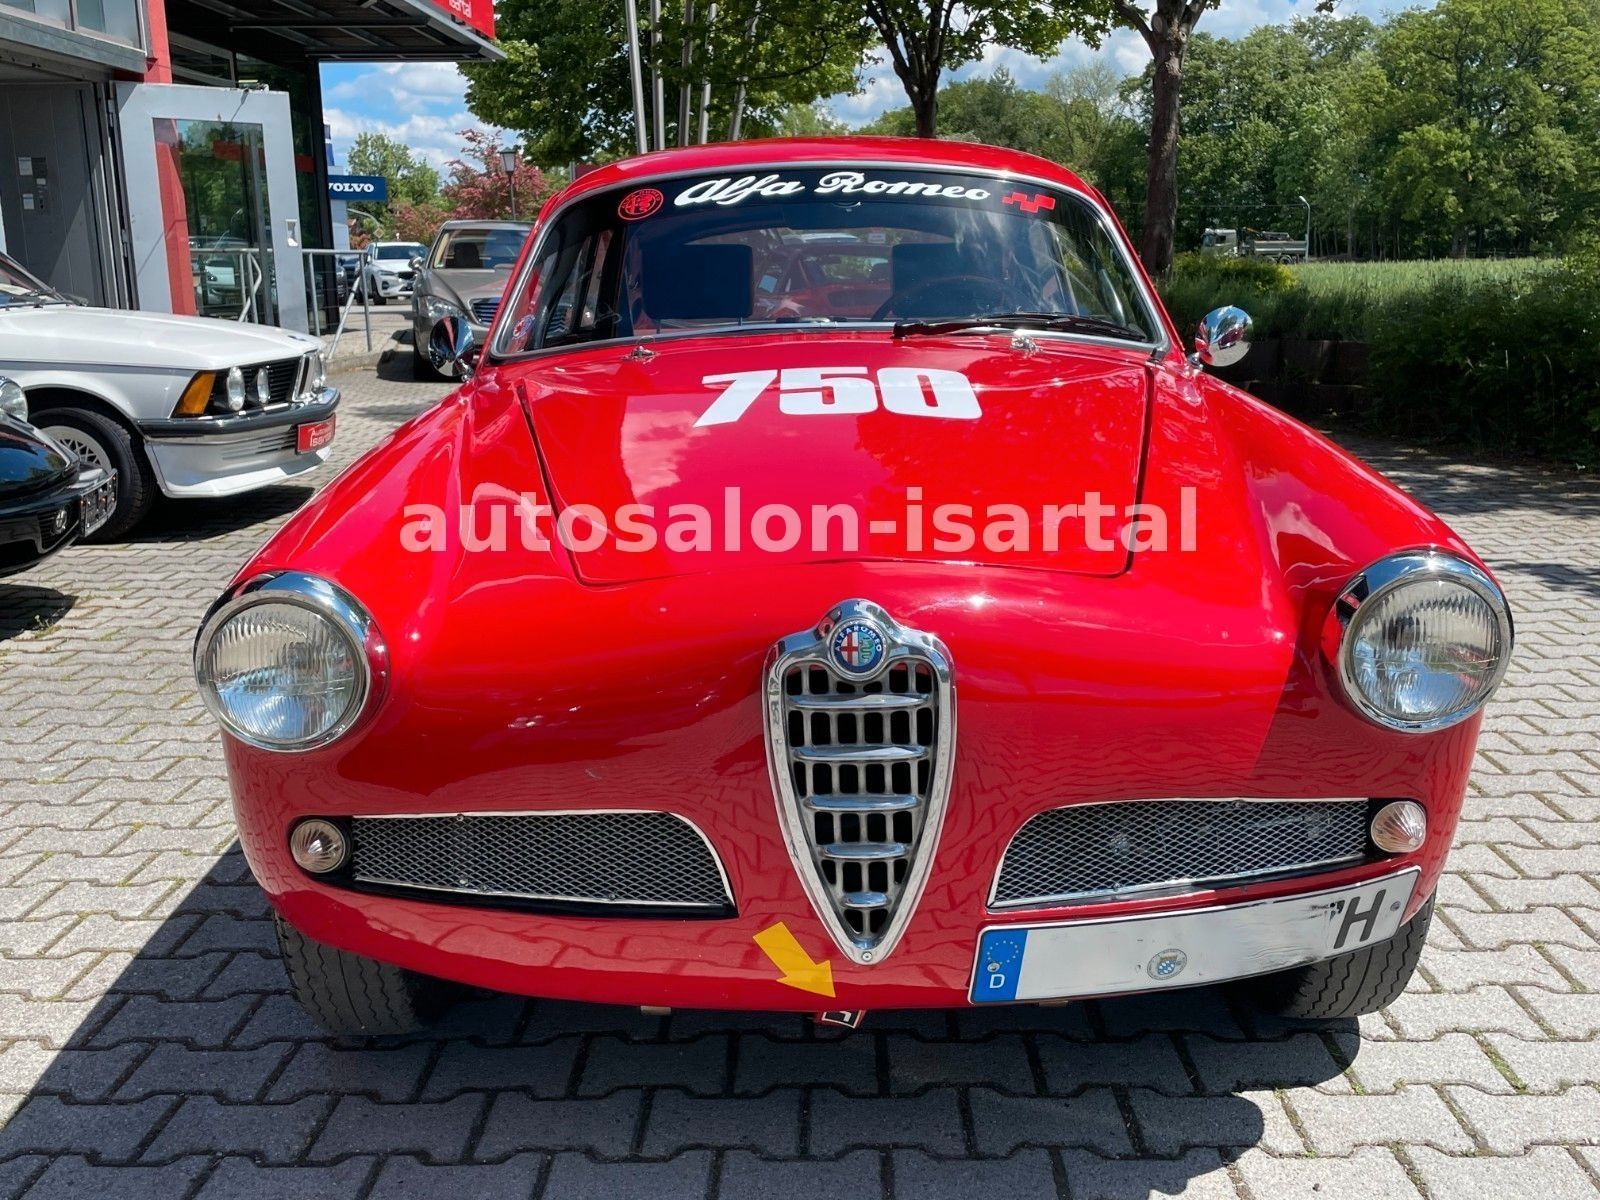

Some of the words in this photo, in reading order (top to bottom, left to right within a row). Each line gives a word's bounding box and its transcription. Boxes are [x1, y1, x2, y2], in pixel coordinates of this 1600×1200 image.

[674, 174, 805, 206] Alfa
[814, 171, 990, 200] Romeo
[692, 366, 983, 428] 750
[835, 627, 852, 652] ALFA
[989, 973, 1006, 989] D
